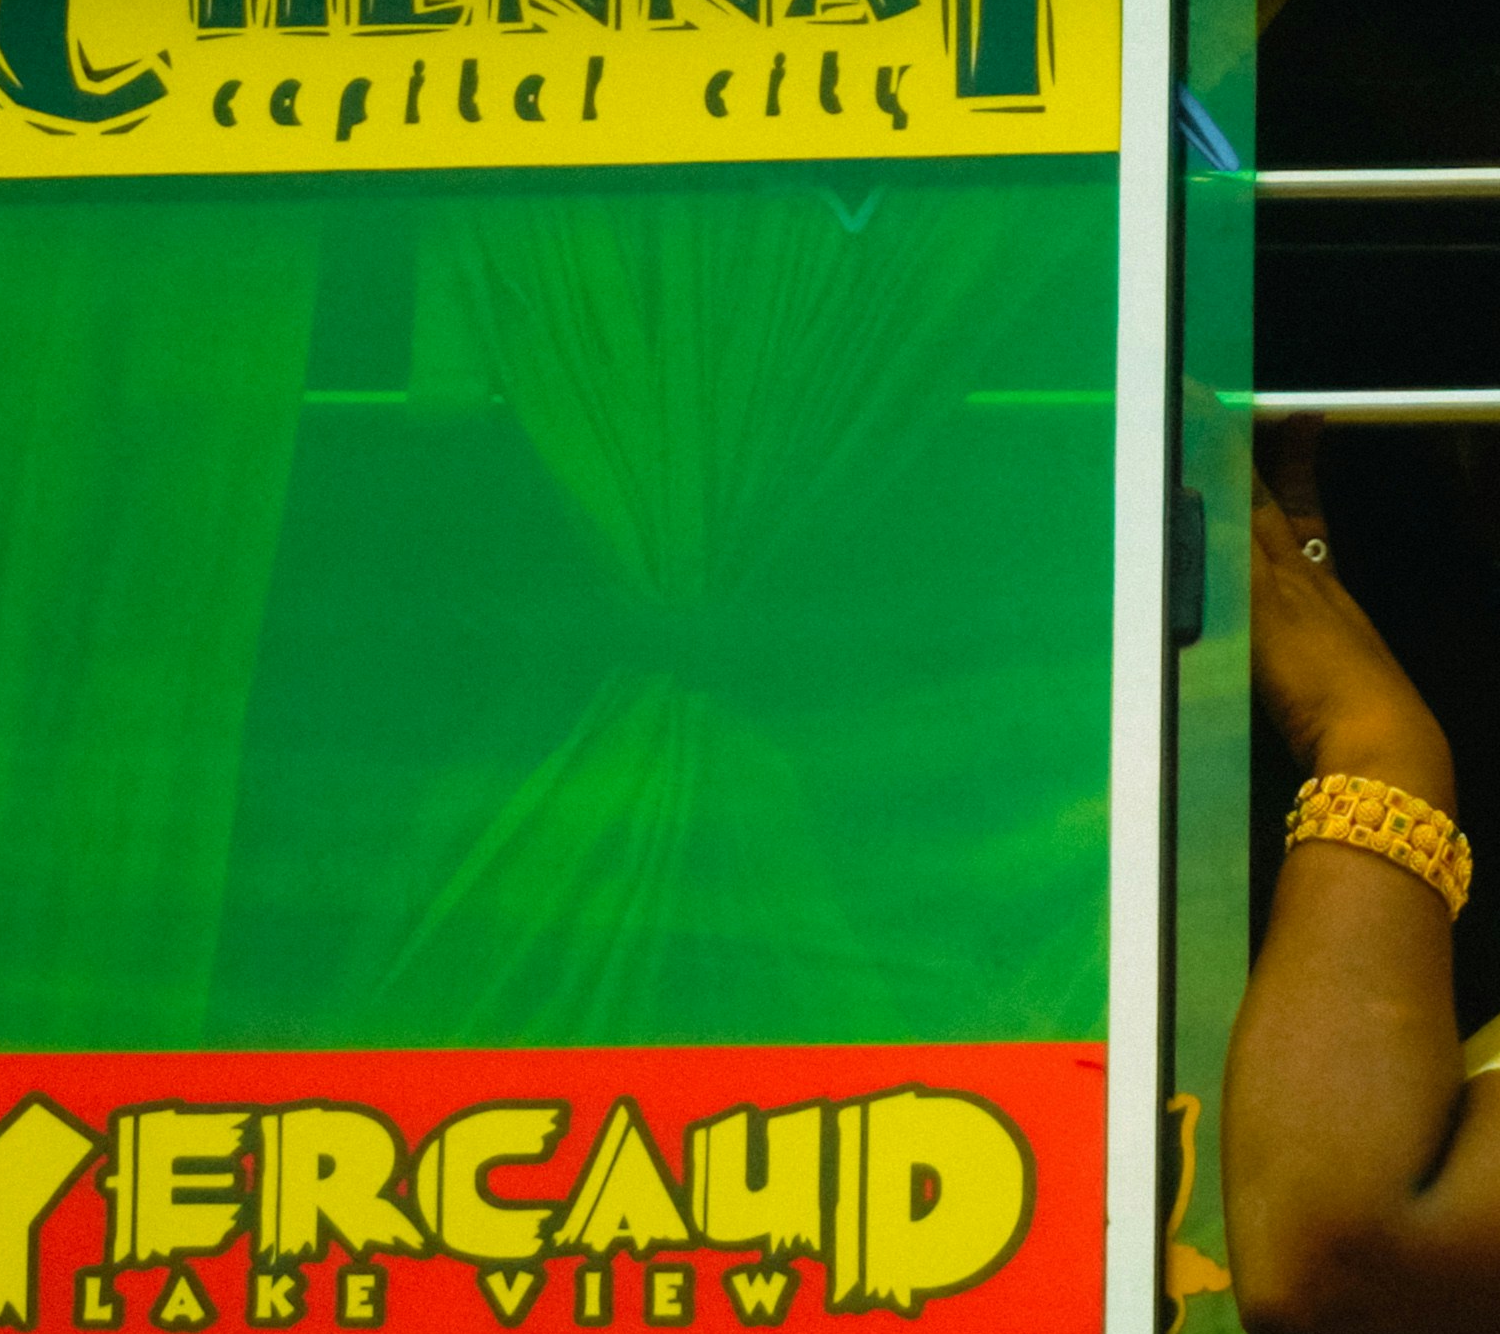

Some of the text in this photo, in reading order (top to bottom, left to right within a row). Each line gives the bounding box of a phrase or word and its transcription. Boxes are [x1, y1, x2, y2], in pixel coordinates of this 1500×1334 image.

[212, 49, 914, 141] capital city
[73, 1255, 806, 1331] LAKE VIEW
